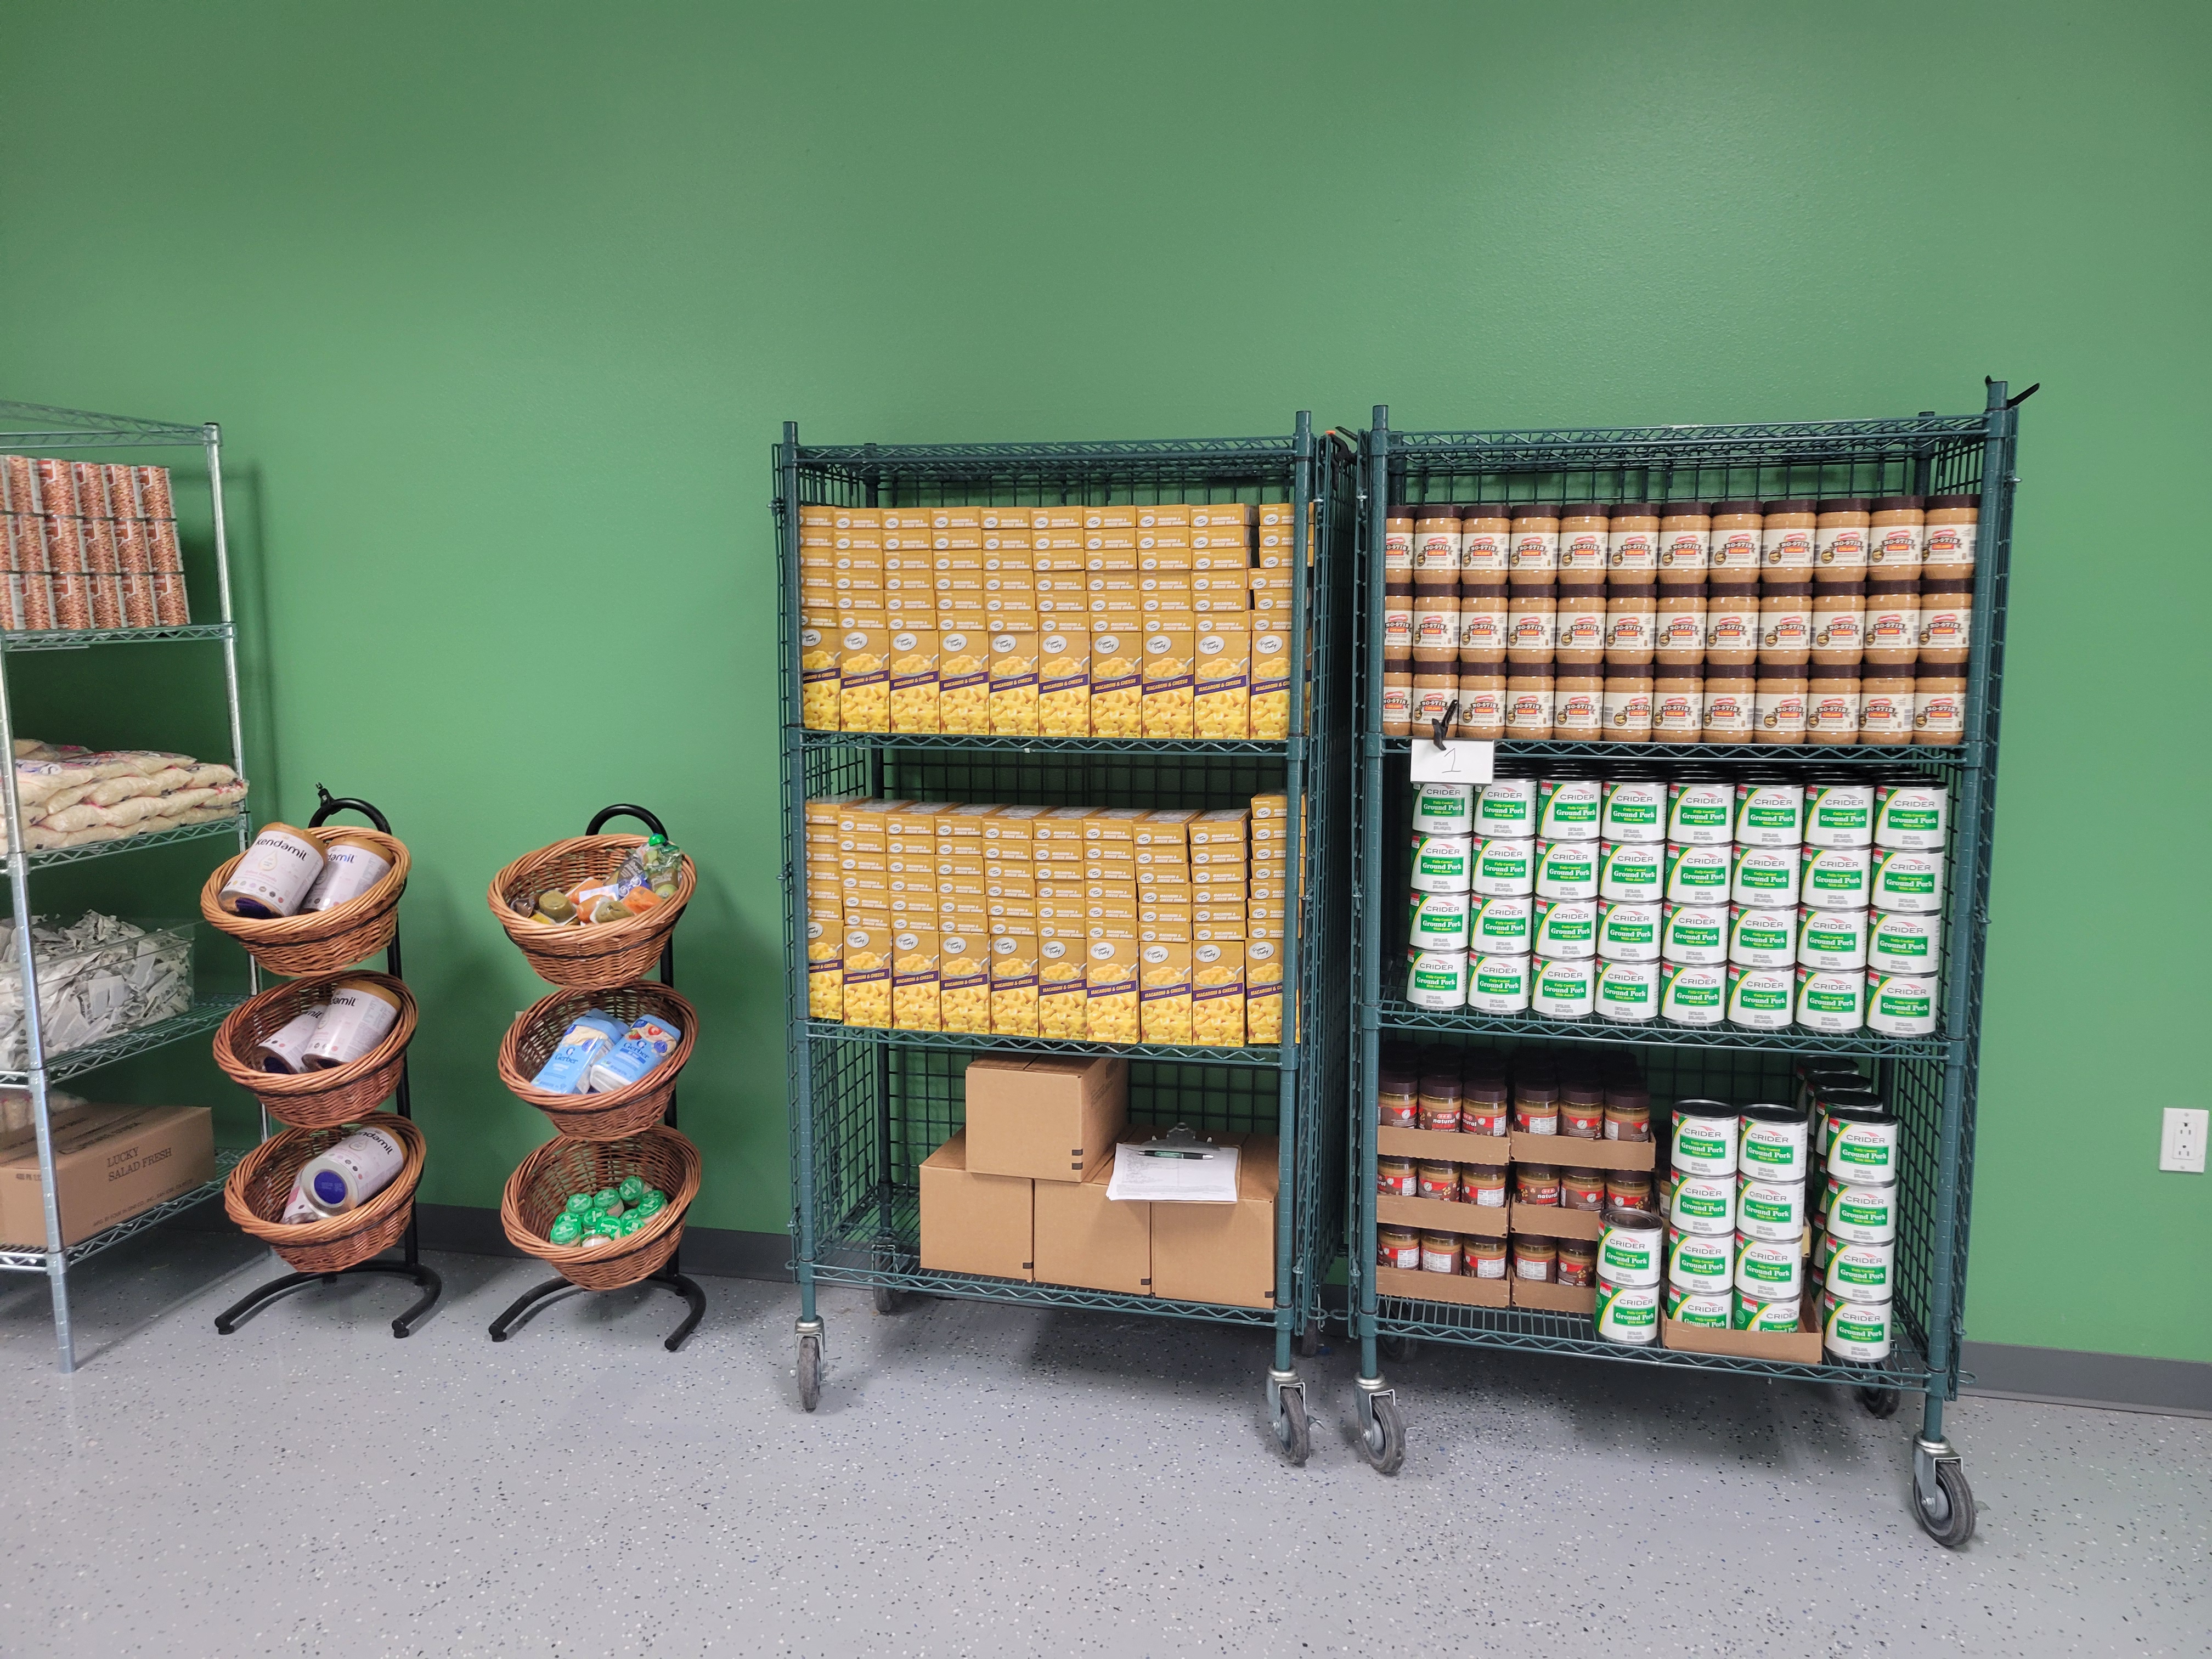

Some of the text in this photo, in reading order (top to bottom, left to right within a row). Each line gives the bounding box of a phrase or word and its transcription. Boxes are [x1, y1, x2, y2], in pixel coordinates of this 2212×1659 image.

[1442, 748, 1462, 773] 1
[1485, 806, 1524, 815] Ground Pork
[1613, 810, 1655, 819] Ground Pork
[1681, 812, 1724, 821] Ground Pork
[255, 838, 307, 861] kendamil
[1484, 865, 1524, 873] Ground Pork
[1549, 868, 1589, 877] Ground Pork
[1613, 870, 1655, 879] Ground Pork
[1682, 872, 1724, 881] Ground Pork
[1423, 919, 1445, 928] Ground
[1485, 923, 1508, 931] Ground
[1610, 929, 1651, 938] Ground Pork
[1675, 932, 1717, 941] Ground Pork
[1417, 977, 1440, 985] Ground
[1608, 973, 1644, 981] CRIDER
[1480, 981, 1503, 989] Ground
[1544, 985, 1568, 994] Ground
[1746, 981, 1784, 989] CRIDER
[1605, 988, 1646, 997] Ground Pork
[1677, 992, 1701, 1001] Ground
[623, 1042, 650, 1059] Gerber
[555, 1053, 578, 1064] Gerber
[1684, 1128, 1722, 1137] CRIDER
[1751, 1132, 1790, 1142] CRIDER
[1845, 1135, 1885, 1144] CRIDER
[1681, 1143, 1723, 1154] Ground Pork
[108, 1147, 138, 1167] LUCKY
[109, 1148, 172, 1181] SALAD FRESH
[1684, 1188, 1722, 1197] CRIDER
[1844, 1195, 1884, 1205] CRIDER
[1610, 1239, 1646, 1248] CRIDER
[1684, 1246, 1722, 1255] CRIDER
[1606, 1254, 1647, 1265] Ground Pork
[1750, 1251, 1788, 1261] CRIDER
[1843, 1255, 1882, 1264] CRIDER
[1681, 1261, 1723, 1271] Ground Pork
[1618, 1300, 1652, 1308] CRIDER
[1687, 1304, 1723, 1313] CRIDER
[1767, 1311, 1797, 1319] CRIDER
[1842, 1313, 1880, 1322] CRIDER
